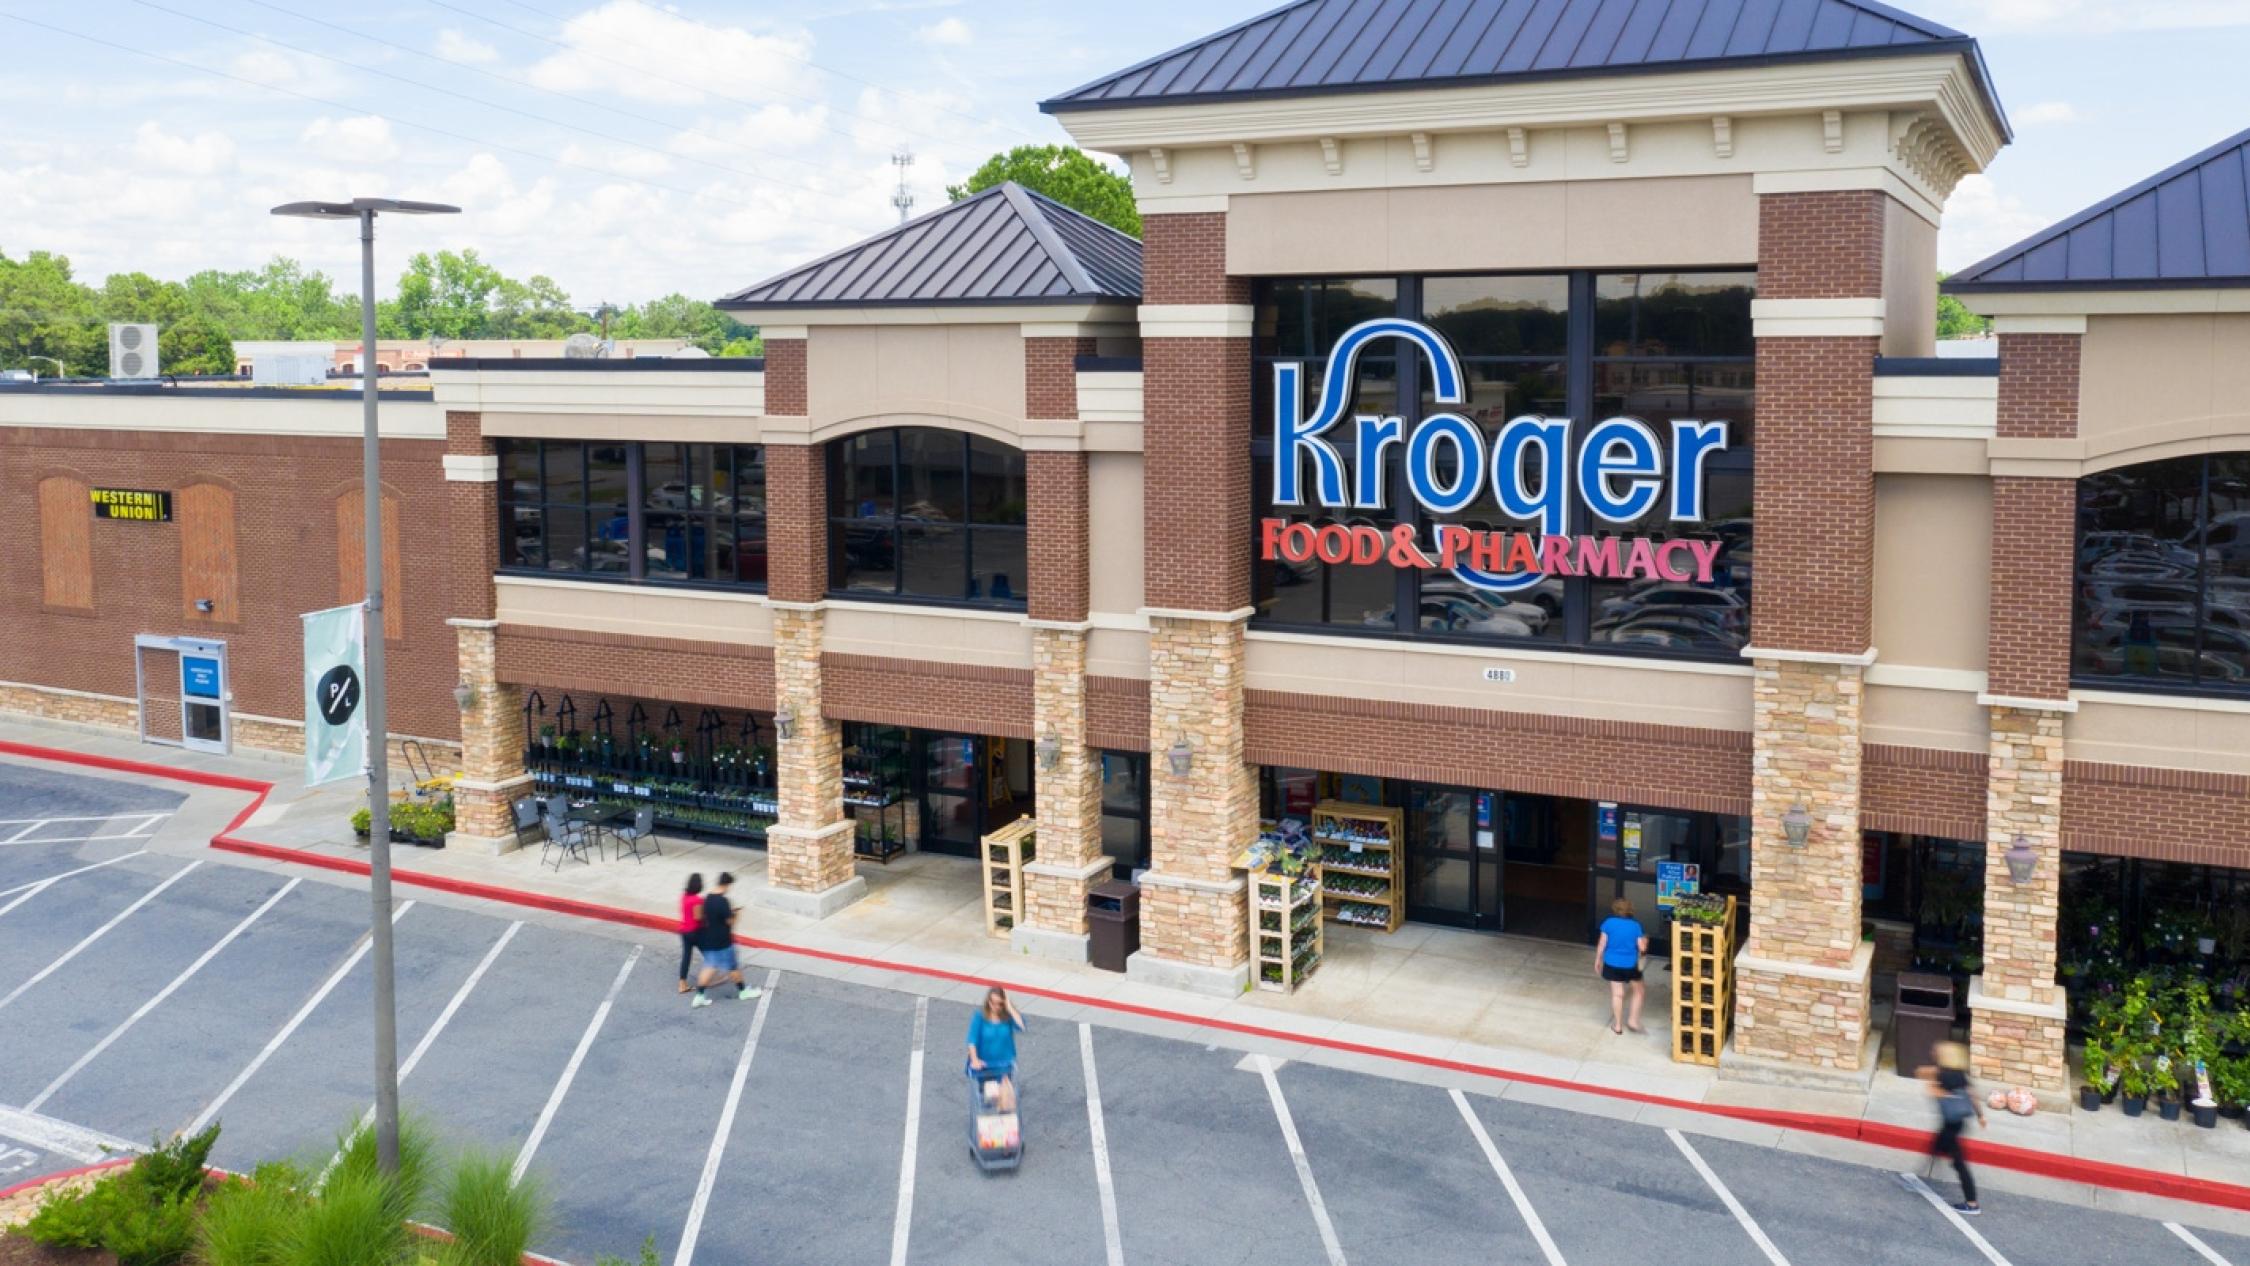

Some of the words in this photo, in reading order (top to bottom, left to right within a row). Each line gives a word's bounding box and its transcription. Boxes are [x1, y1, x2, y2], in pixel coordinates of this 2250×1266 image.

[1272, 317, 1729, 592] Kroger
[90, 489, 153, 506] WESTERN
[110, 504, 153, 520] UNION
[1261, 518, 1385, 566] FOOD
[1388, 523, 1437, 569] &
[1440, 525, 1723, 582] PHARMACY
